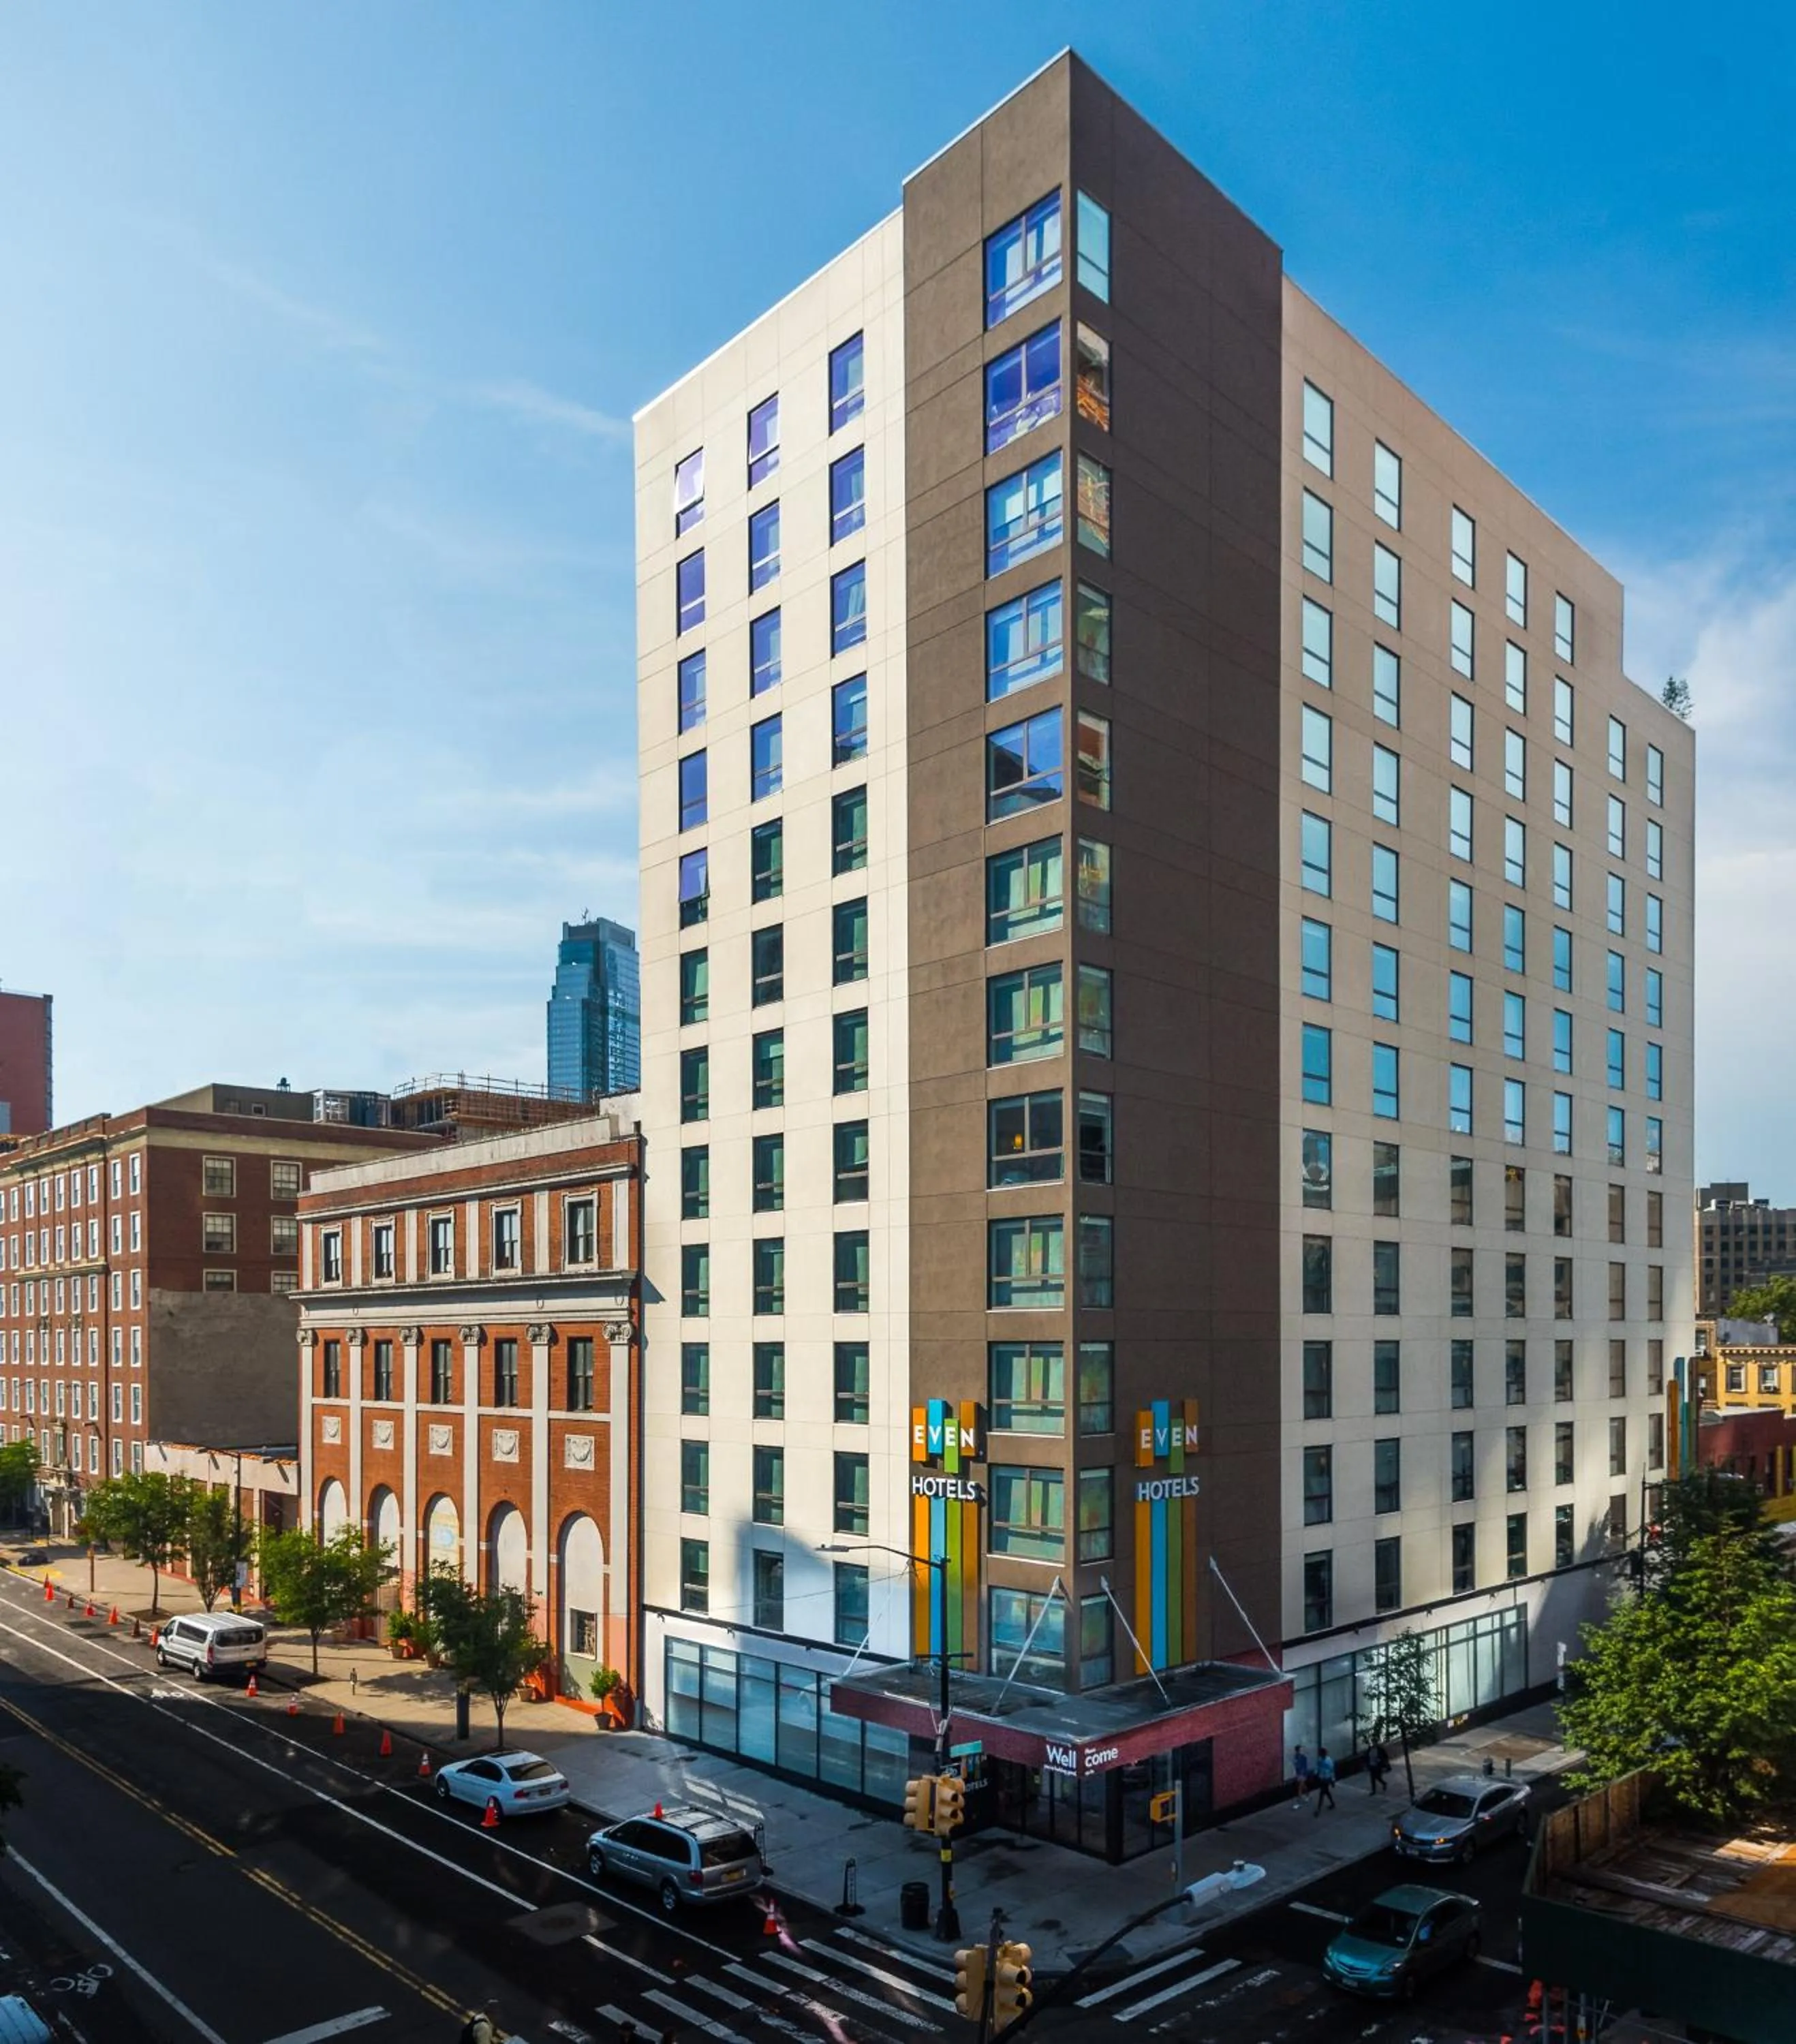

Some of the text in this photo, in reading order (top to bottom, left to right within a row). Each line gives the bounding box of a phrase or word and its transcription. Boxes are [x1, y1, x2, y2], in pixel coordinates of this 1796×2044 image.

[913, 1425, 974, 1449] EVEN
[1141, 1425, 1198, 1449] EVEN
[912, 1476, 976, 1500] HOTELS
[1138, 1476, 1200, 1502] HOTELS
[1046, 1744, 1119, 1769] Well come
